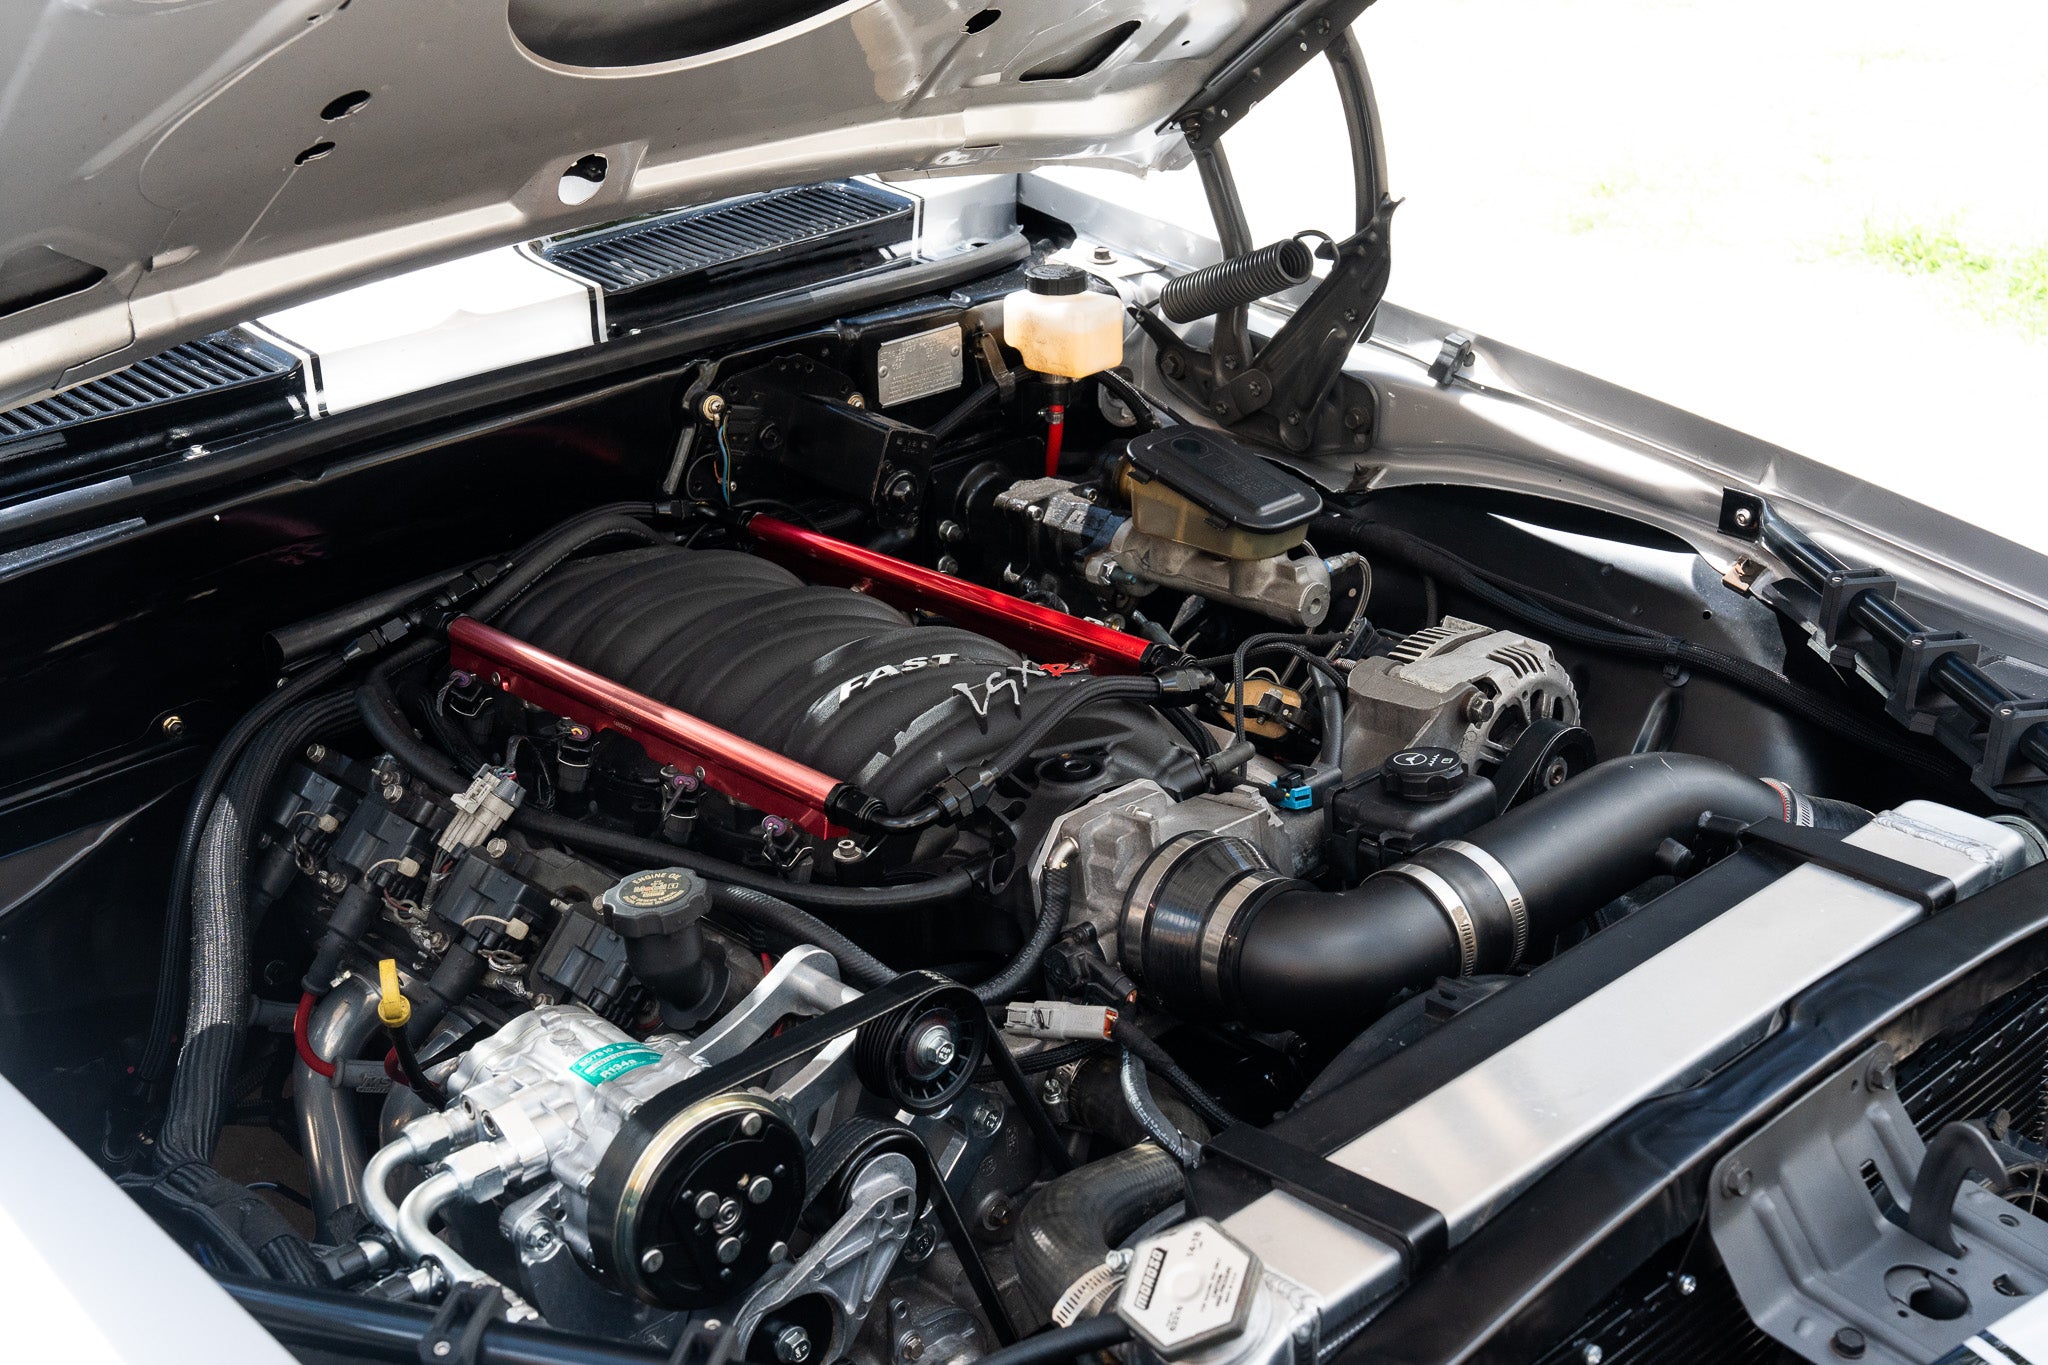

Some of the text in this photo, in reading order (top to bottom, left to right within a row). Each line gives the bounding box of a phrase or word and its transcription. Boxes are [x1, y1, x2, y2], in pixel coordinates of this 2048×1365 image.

[838, 653, 959, 703] FAST
[632, 872, 667, 885] ENGINE
[1135, 1247, 1167, 1311] MOROSO
